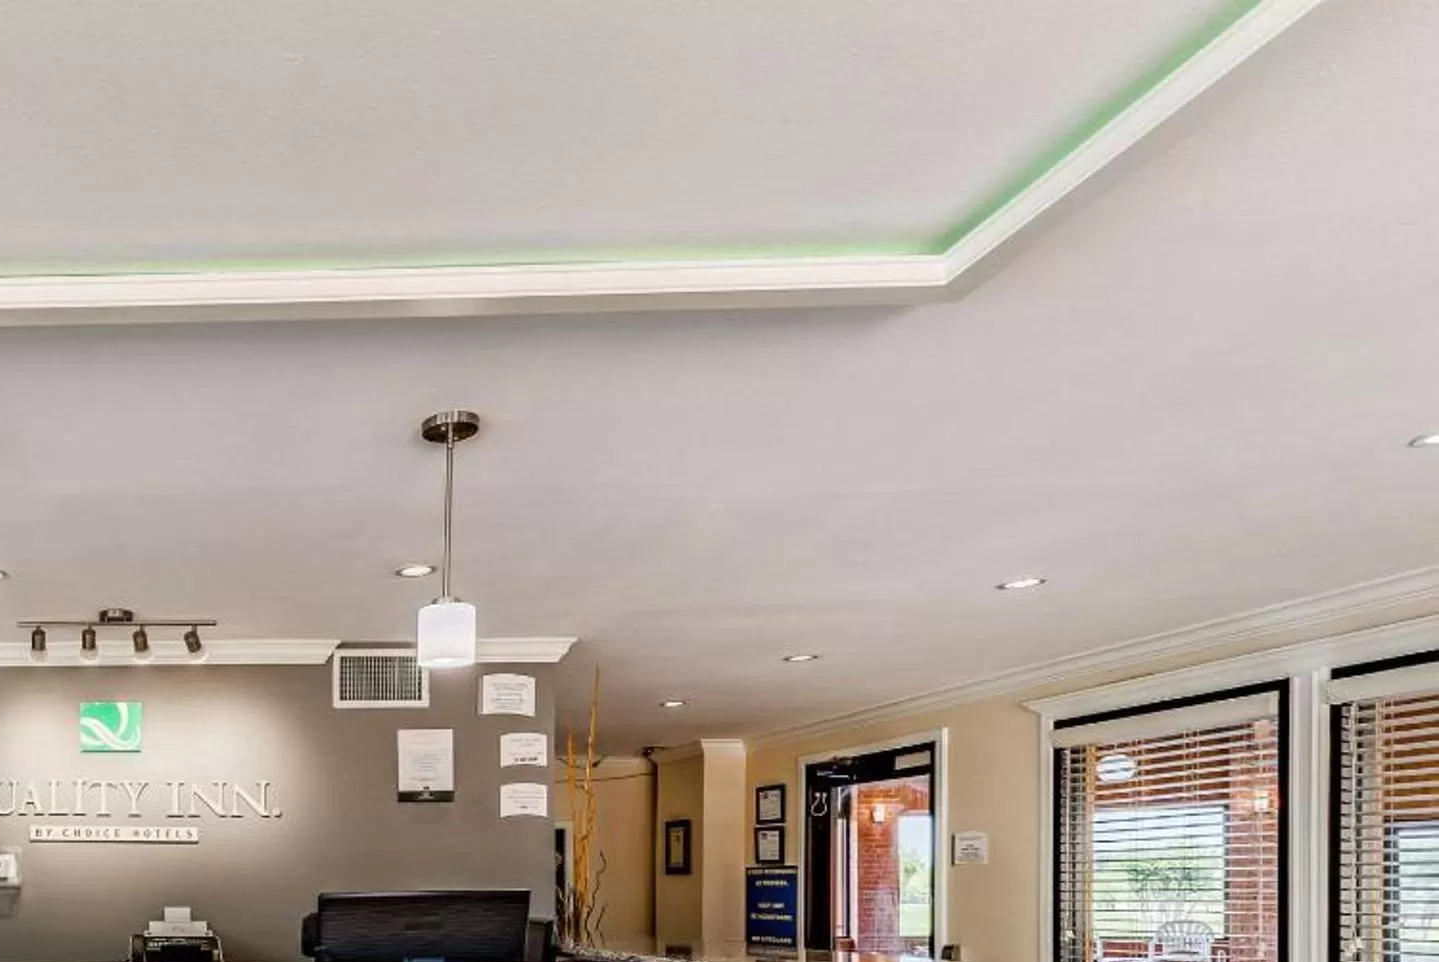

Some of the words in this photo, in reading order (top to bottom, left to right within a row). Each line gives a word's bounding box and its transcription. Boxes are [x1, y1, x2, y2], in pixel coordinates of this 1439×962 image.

[34, 828, 53, 838] BY
[61, 828, 122, 838] CHOICE
[132, 828, 194, 839] HOTELS
